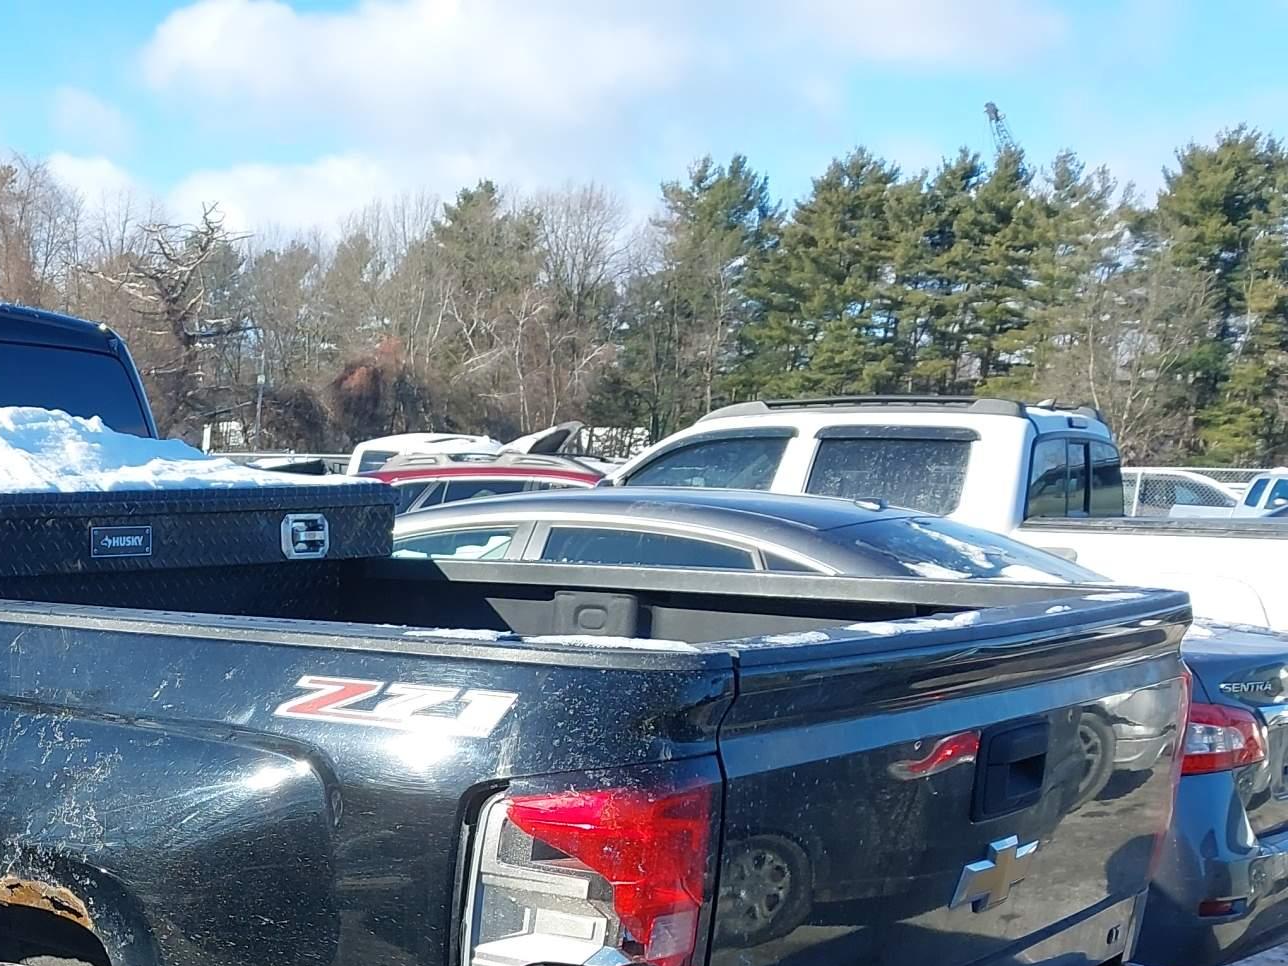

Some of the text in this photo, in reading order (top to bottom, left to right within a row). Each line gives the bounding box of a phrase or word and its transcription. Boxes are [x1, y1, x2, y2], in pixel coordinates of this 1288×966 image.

[112, 535, 143, 547] HUSKY
[1221, 681, 1272, 693] SENTRA
[272, 674, 520, 739] Z71
